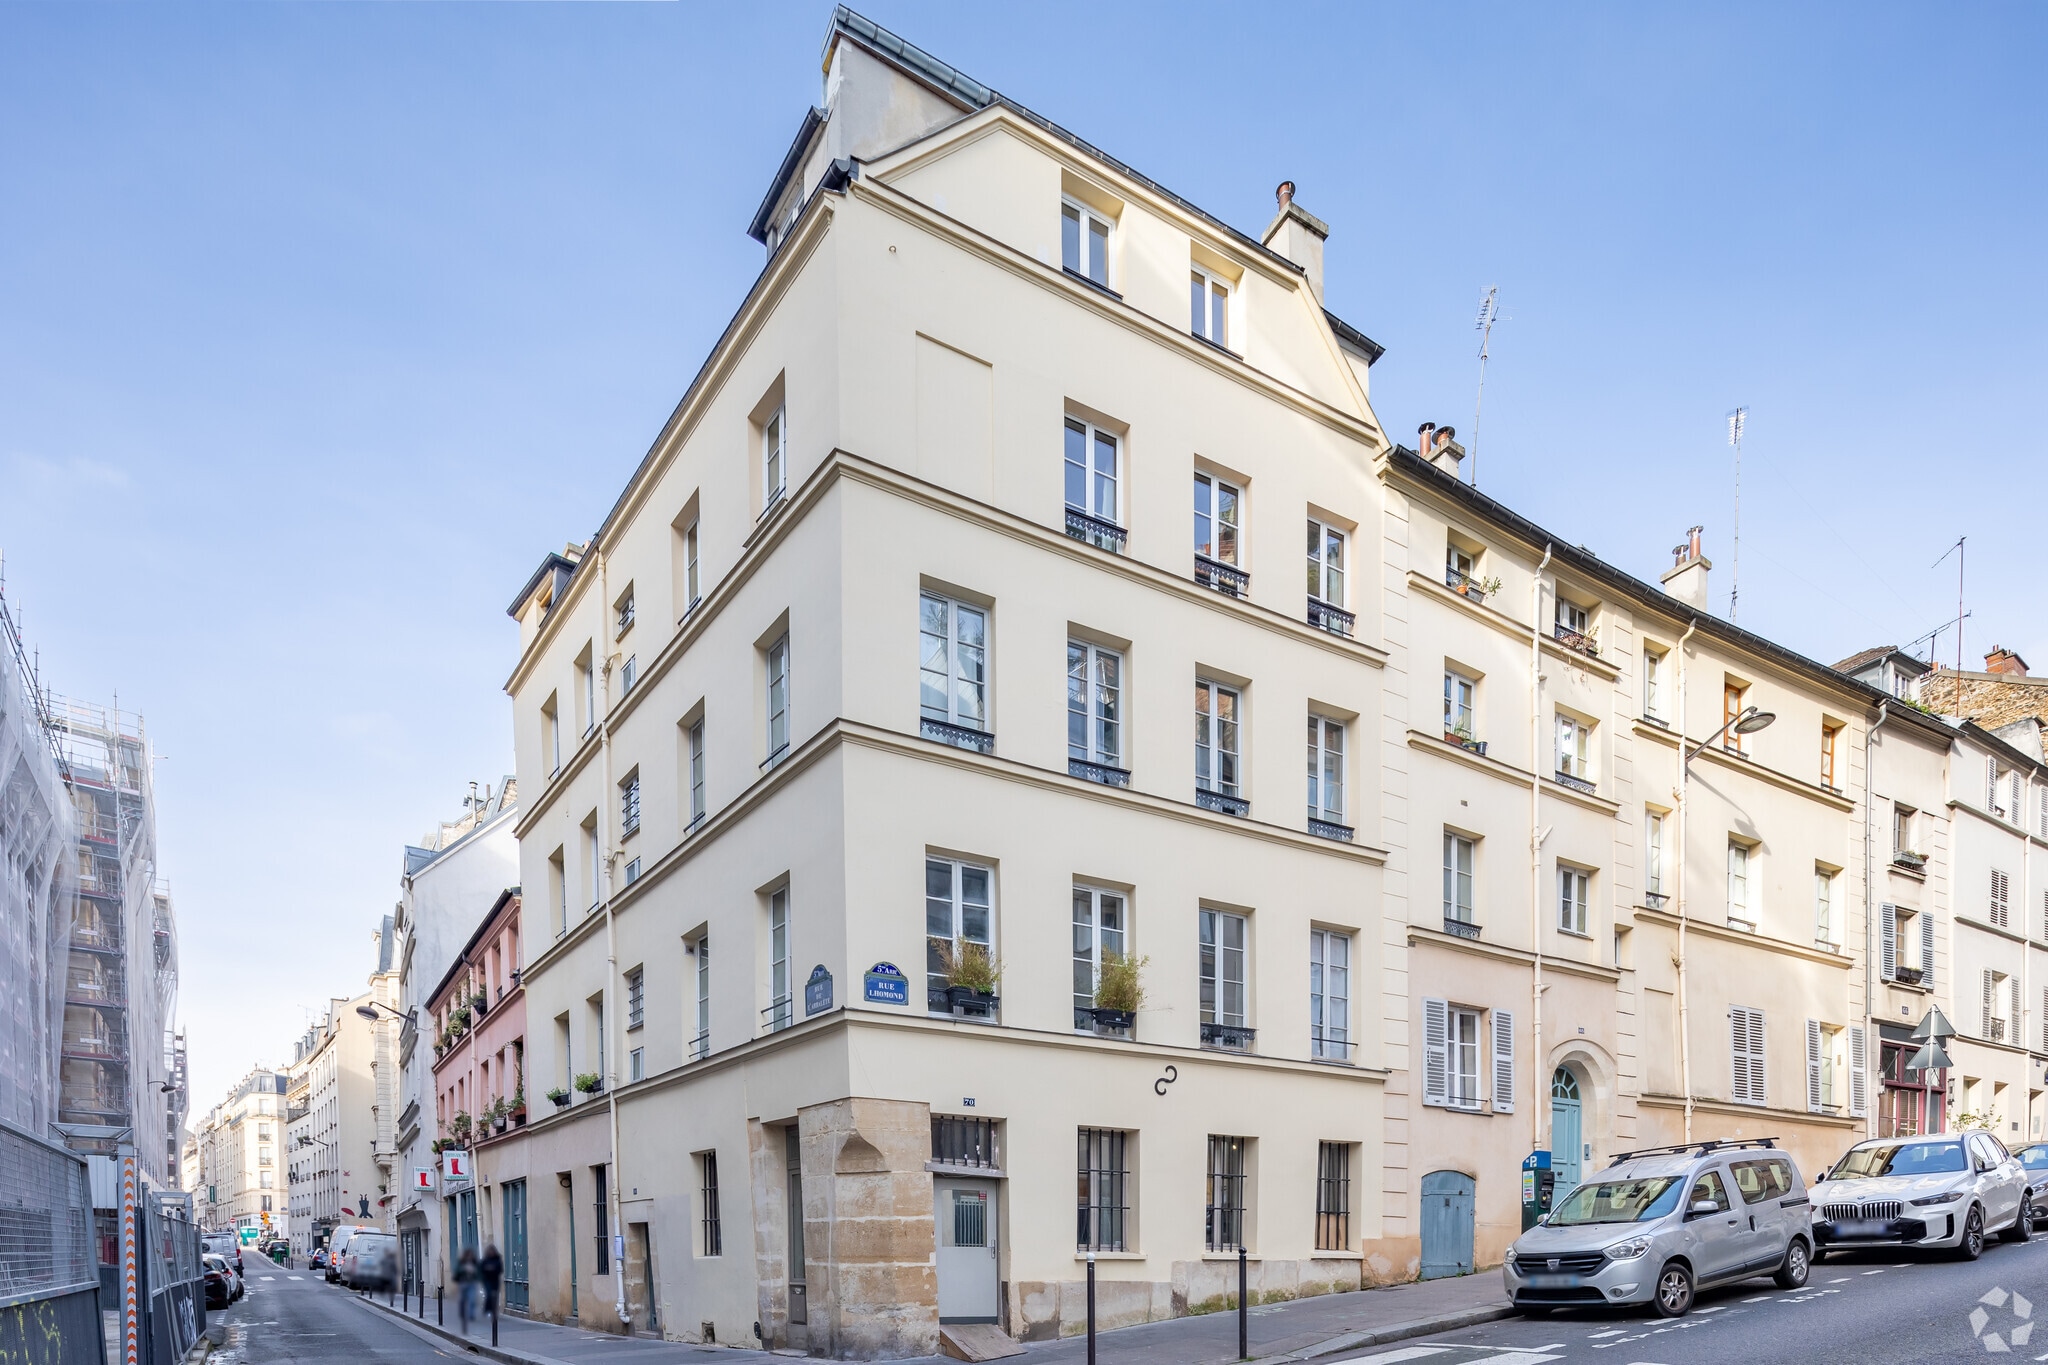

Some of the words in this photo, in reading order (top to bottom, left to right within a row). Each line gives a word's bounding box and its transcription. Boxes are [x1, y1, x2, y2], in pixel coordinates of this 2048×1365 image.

[878, 982, 895, 990] RUE
[869, 989, 904, 1000] LHOMOND
[964, 1098, 975, 1106] 70
[1529, 1155, 1538, 1168] P
